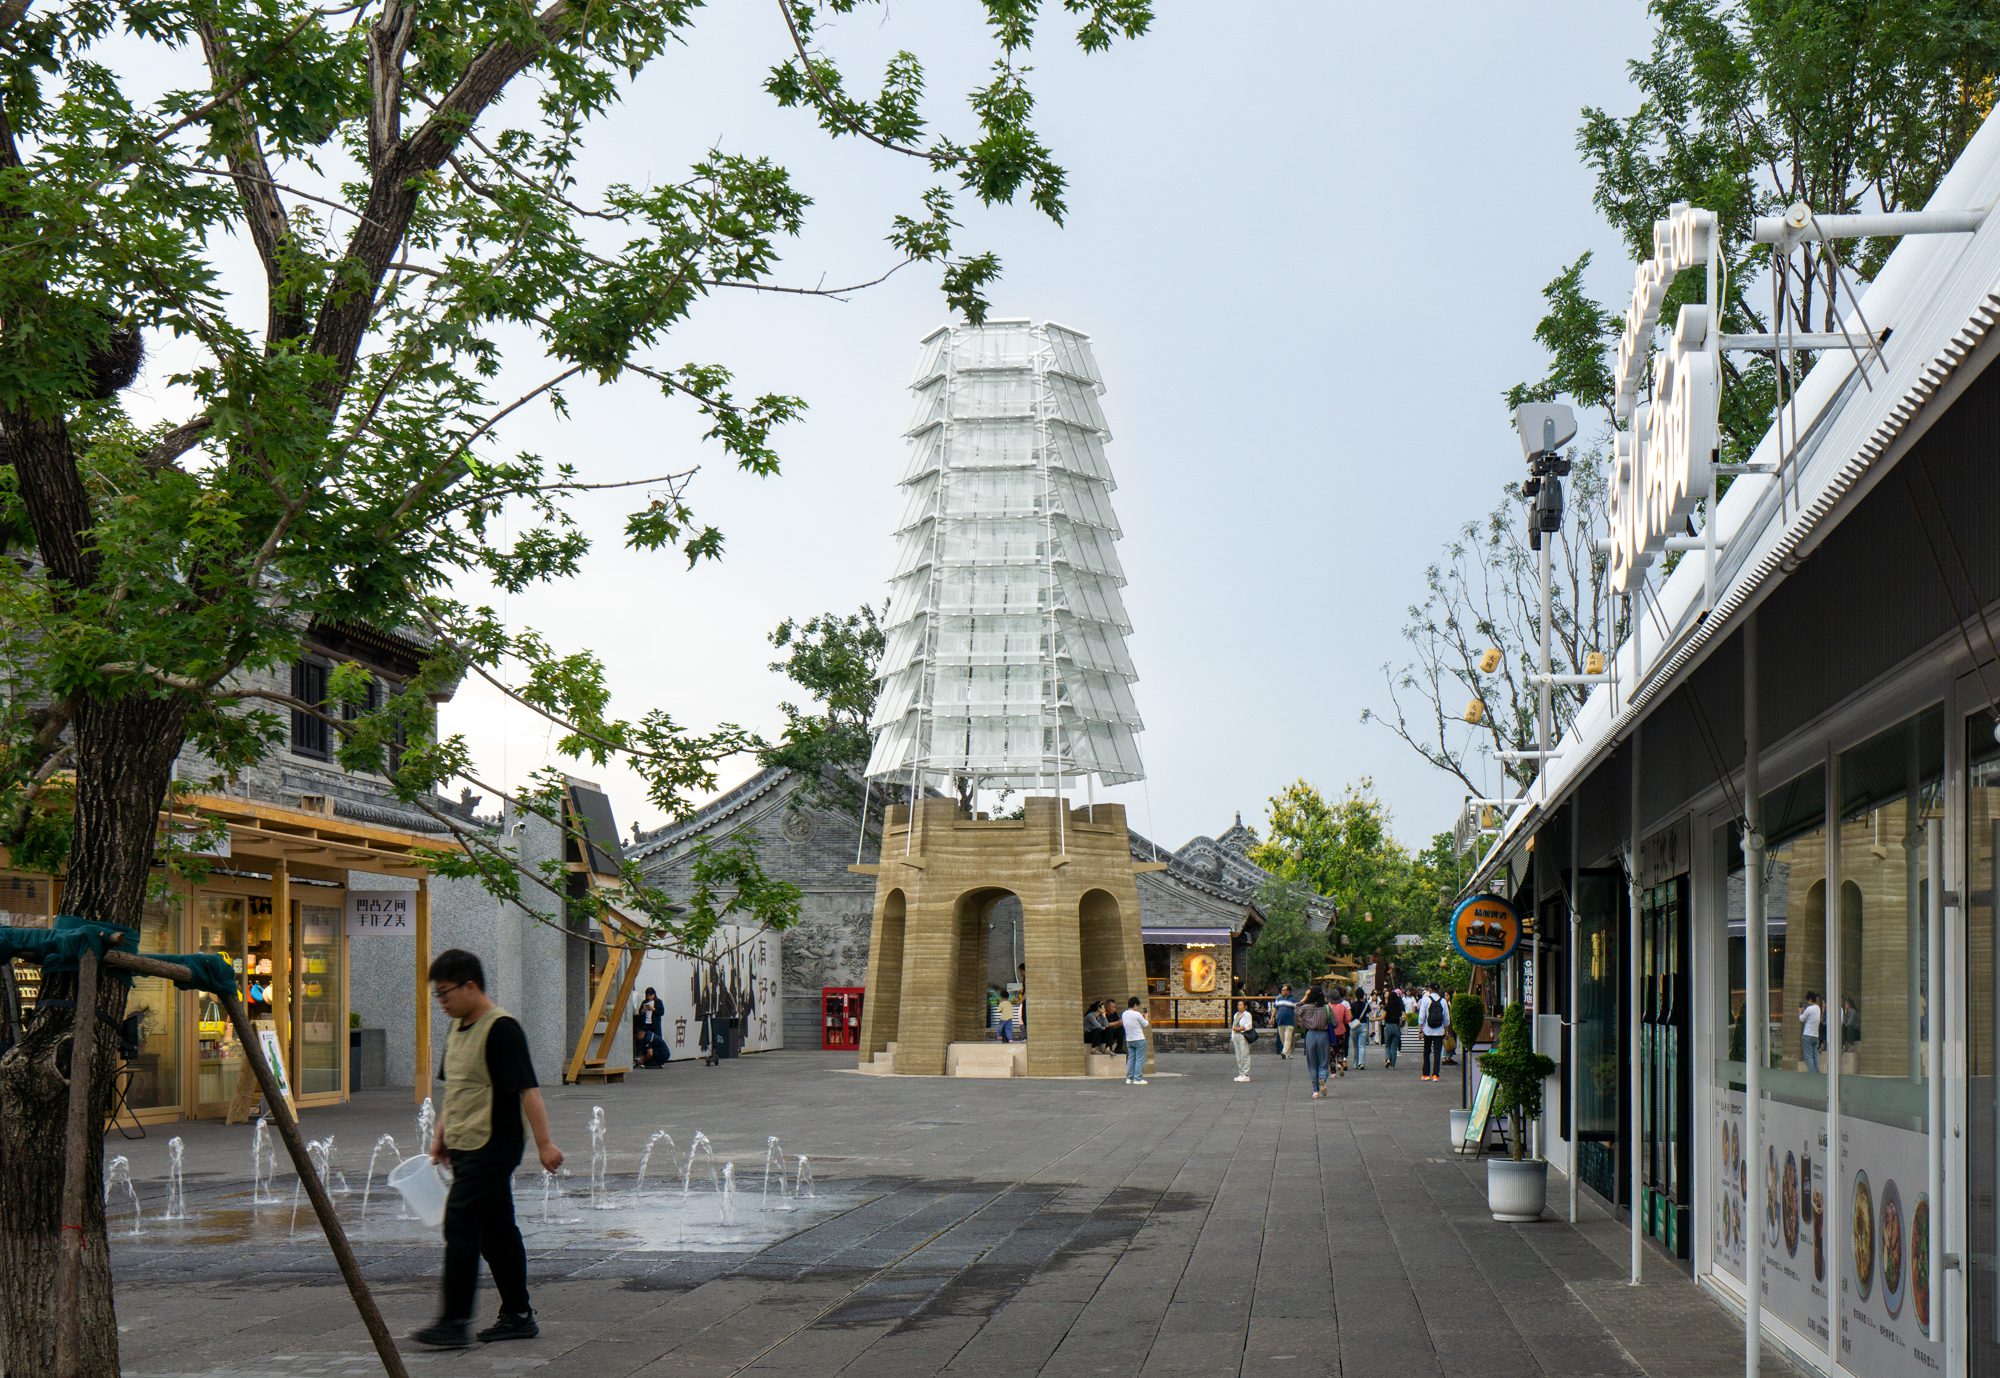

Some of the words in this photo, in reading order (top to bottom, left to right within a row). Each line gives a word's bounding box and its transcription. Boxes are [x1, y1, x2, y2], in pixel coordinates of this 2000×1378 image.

[1653, 219, 1665, 287] &
[1670, 203, 1697, 269] bar
[356, 898, 406, 912] 凹凸之间
[356, 913, 406, 927] 手作之美
[757, 937, 769, 1043] 有好戏
